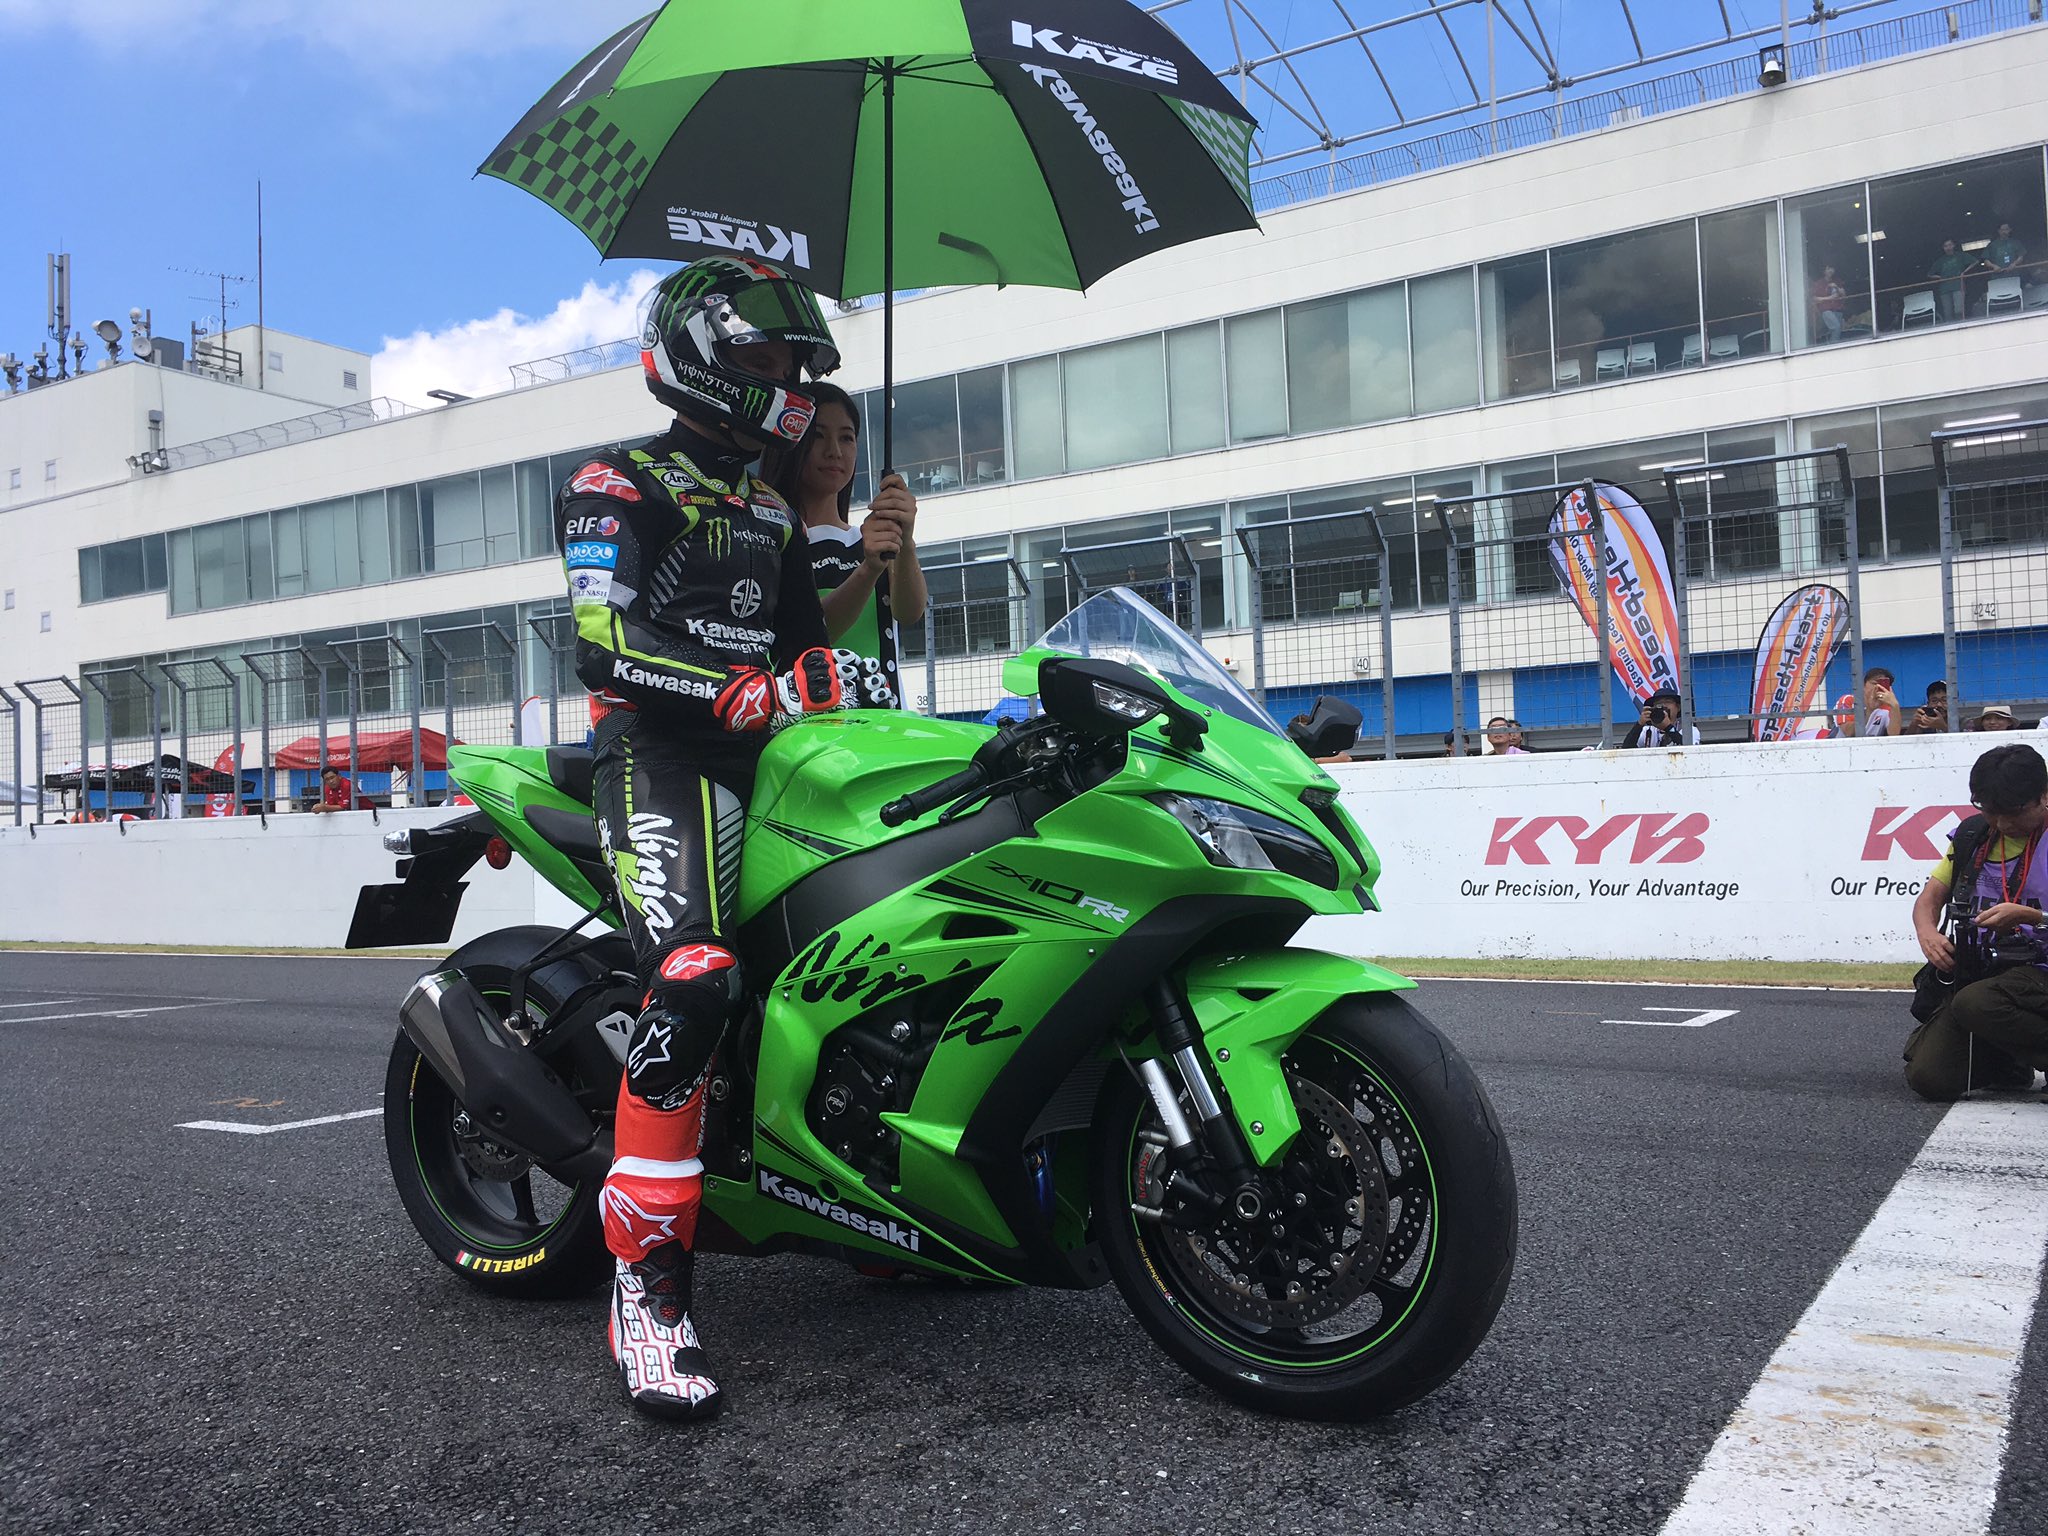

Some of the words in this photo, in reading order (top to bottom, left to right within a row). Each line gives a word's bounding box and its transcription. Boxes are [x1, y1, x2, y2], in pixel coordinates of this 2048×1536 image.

[1011, 20, 1179, 85] KAZE
[1072, 35, 1117, 52] Kawasaki
[1152, 56, 1175, 67] Club
[677, 361, 741, 400] MONSTER
[682, 377, 732, 403] ENERGY
[566, 516, 598, 535] elf
[732, 529, 777, 547] MONSTE
[812, 556, 862, 571] Kawaki
[686, 618, 777, 646] Kawasa
[702, 636, 751, 654] Racing
[1356, 657, 1369, 671] 40
[1794, 654, 1818, 703] Technology
[1812, 627, 1827, 655] Motor
[613, 659, 720, 700] Kawasak
[916, 695, 929, 706] 38
[1484, 811, 1711, 866] KYB
[1460, 879, 1490, 898] Our
[1494, 879, 1581, 901] Precision,
[1588, 879, 1632, 897] Your
[1636, 877, 1740, 902] Advantage
[1830, 876, 1869, 897] Our
[782, 930, 1023, 1046] Nina
[1138, 1152, 1151, 1199] brembo
[760, 1170, 920, 1253] Kawasaki
[473, 1247, 545, 1273] PIRELLI
[643, 1347, 663, 1383] 65
